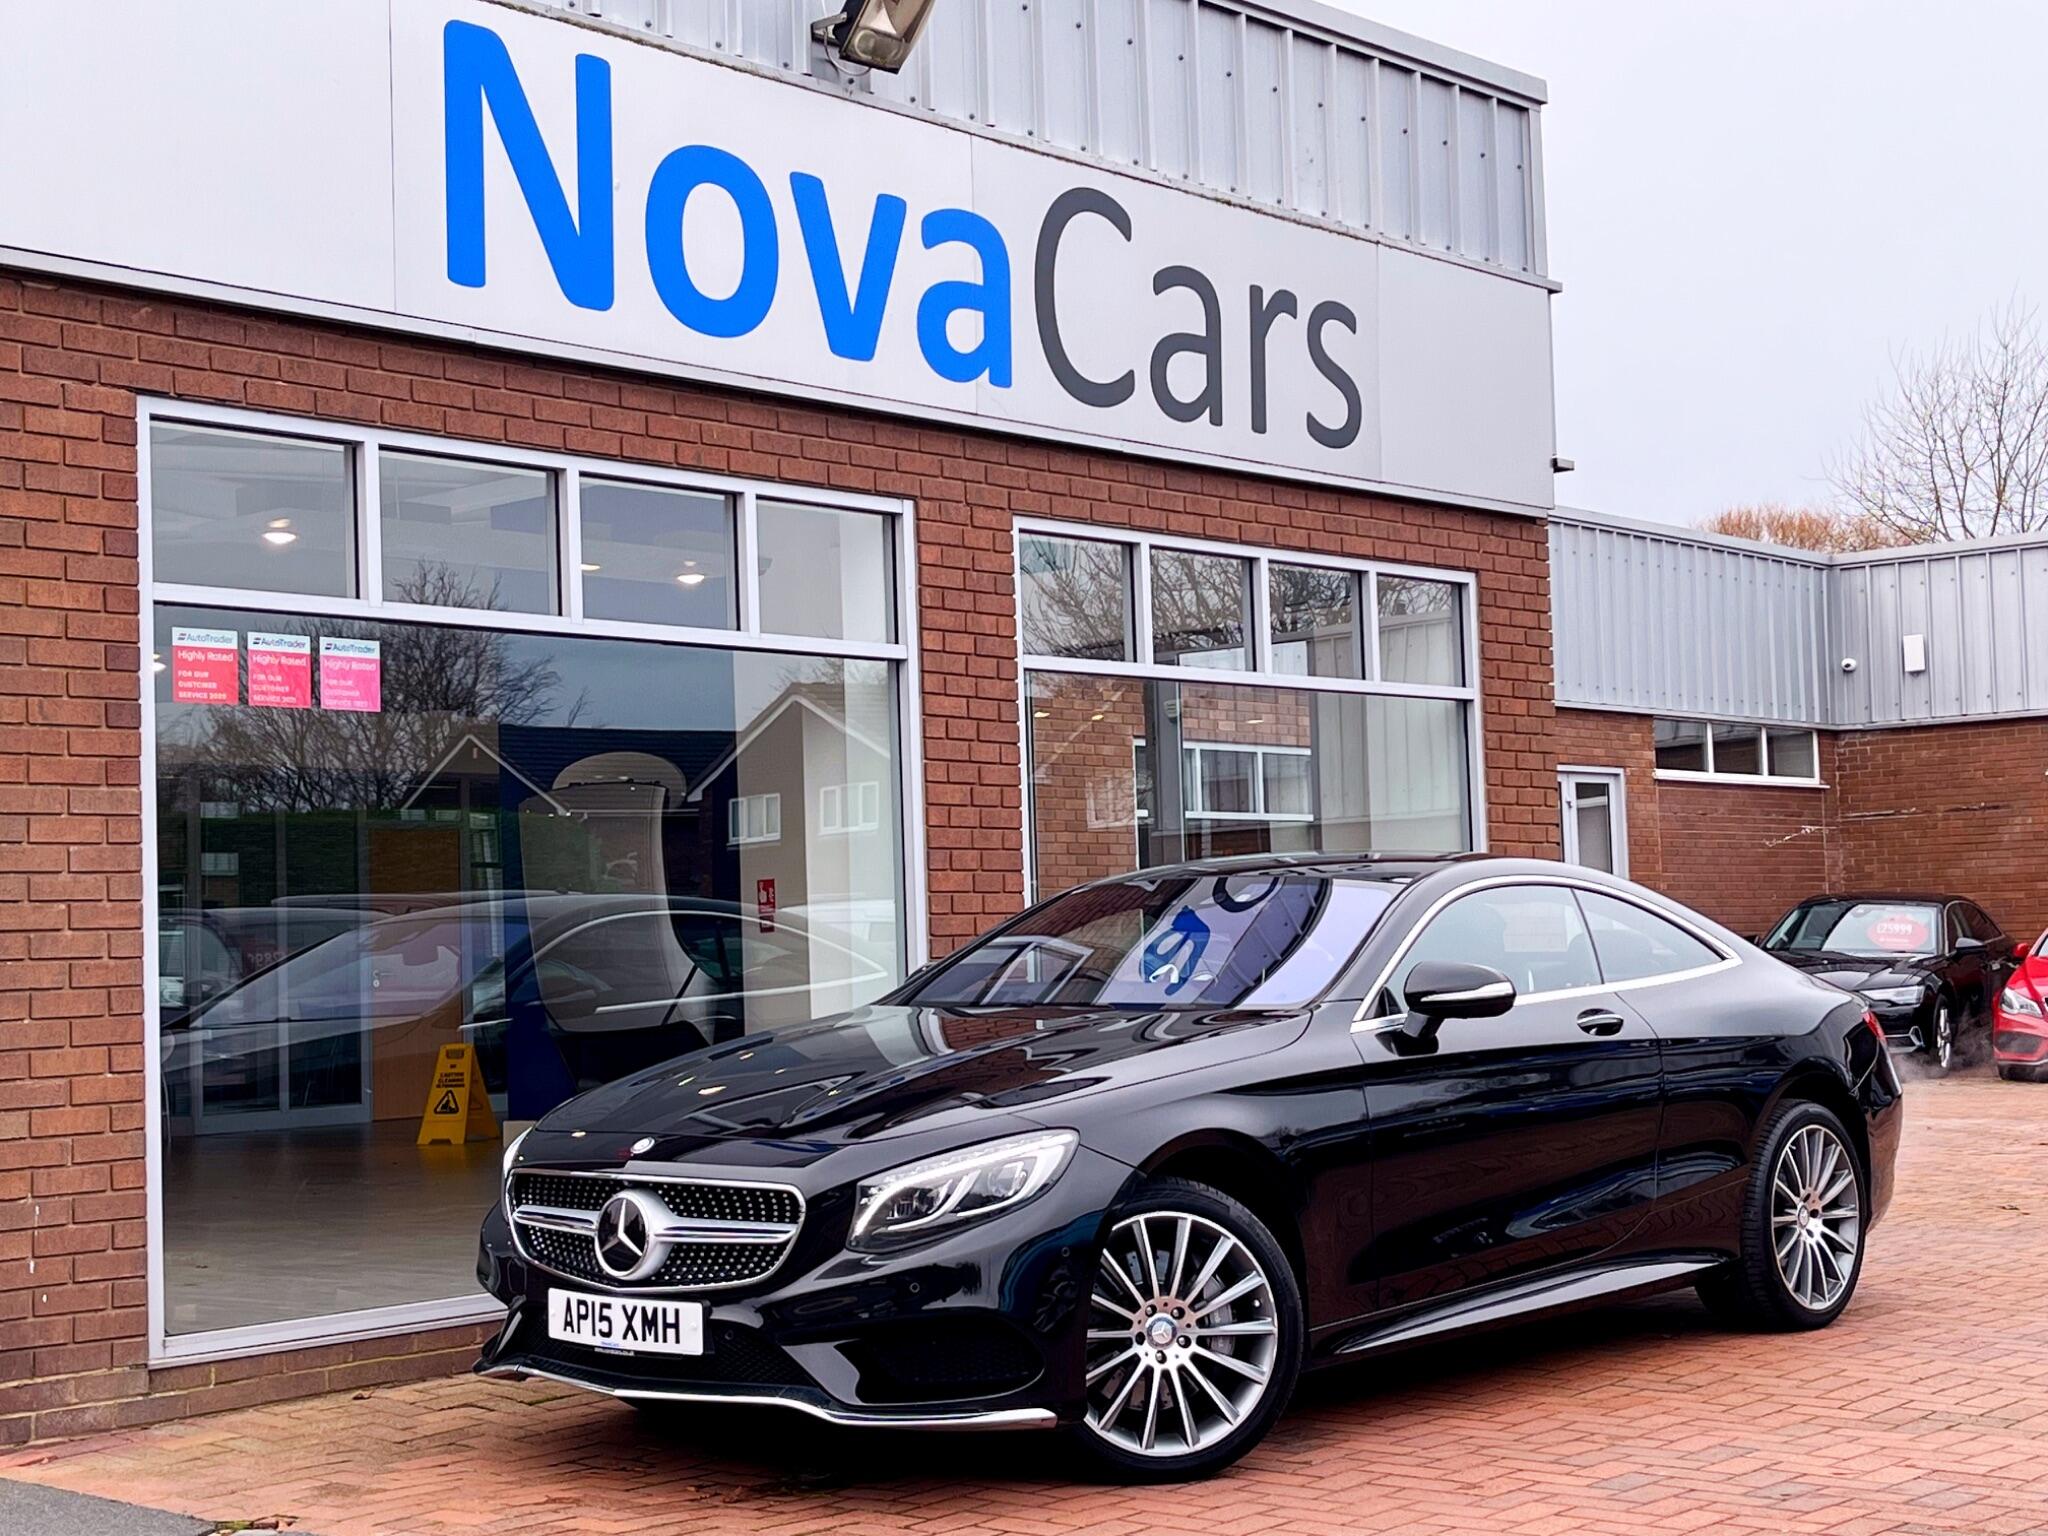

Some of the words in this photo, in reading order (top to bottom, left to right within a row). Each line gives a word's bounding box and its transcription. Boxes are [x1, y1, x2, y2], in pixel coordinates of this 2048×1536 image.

[186, 633, 233, 644] AutoTrader
[261, 638, 306, 649] AutoTrader
[333, 643, 376, 654] AutoTrader
[177, 650, 206, 662] Highly
[207, 652, 234, 662] Rated
[252, 654, 280, 666] Highly
[281, 656, 307, 666] Rated
[323, 658, 351, 671] Highly
[351, 661, 377, 671] Rated
[563, 1297, 613, 1339] AP15
[621, 1304, 681, 1345] XMH
